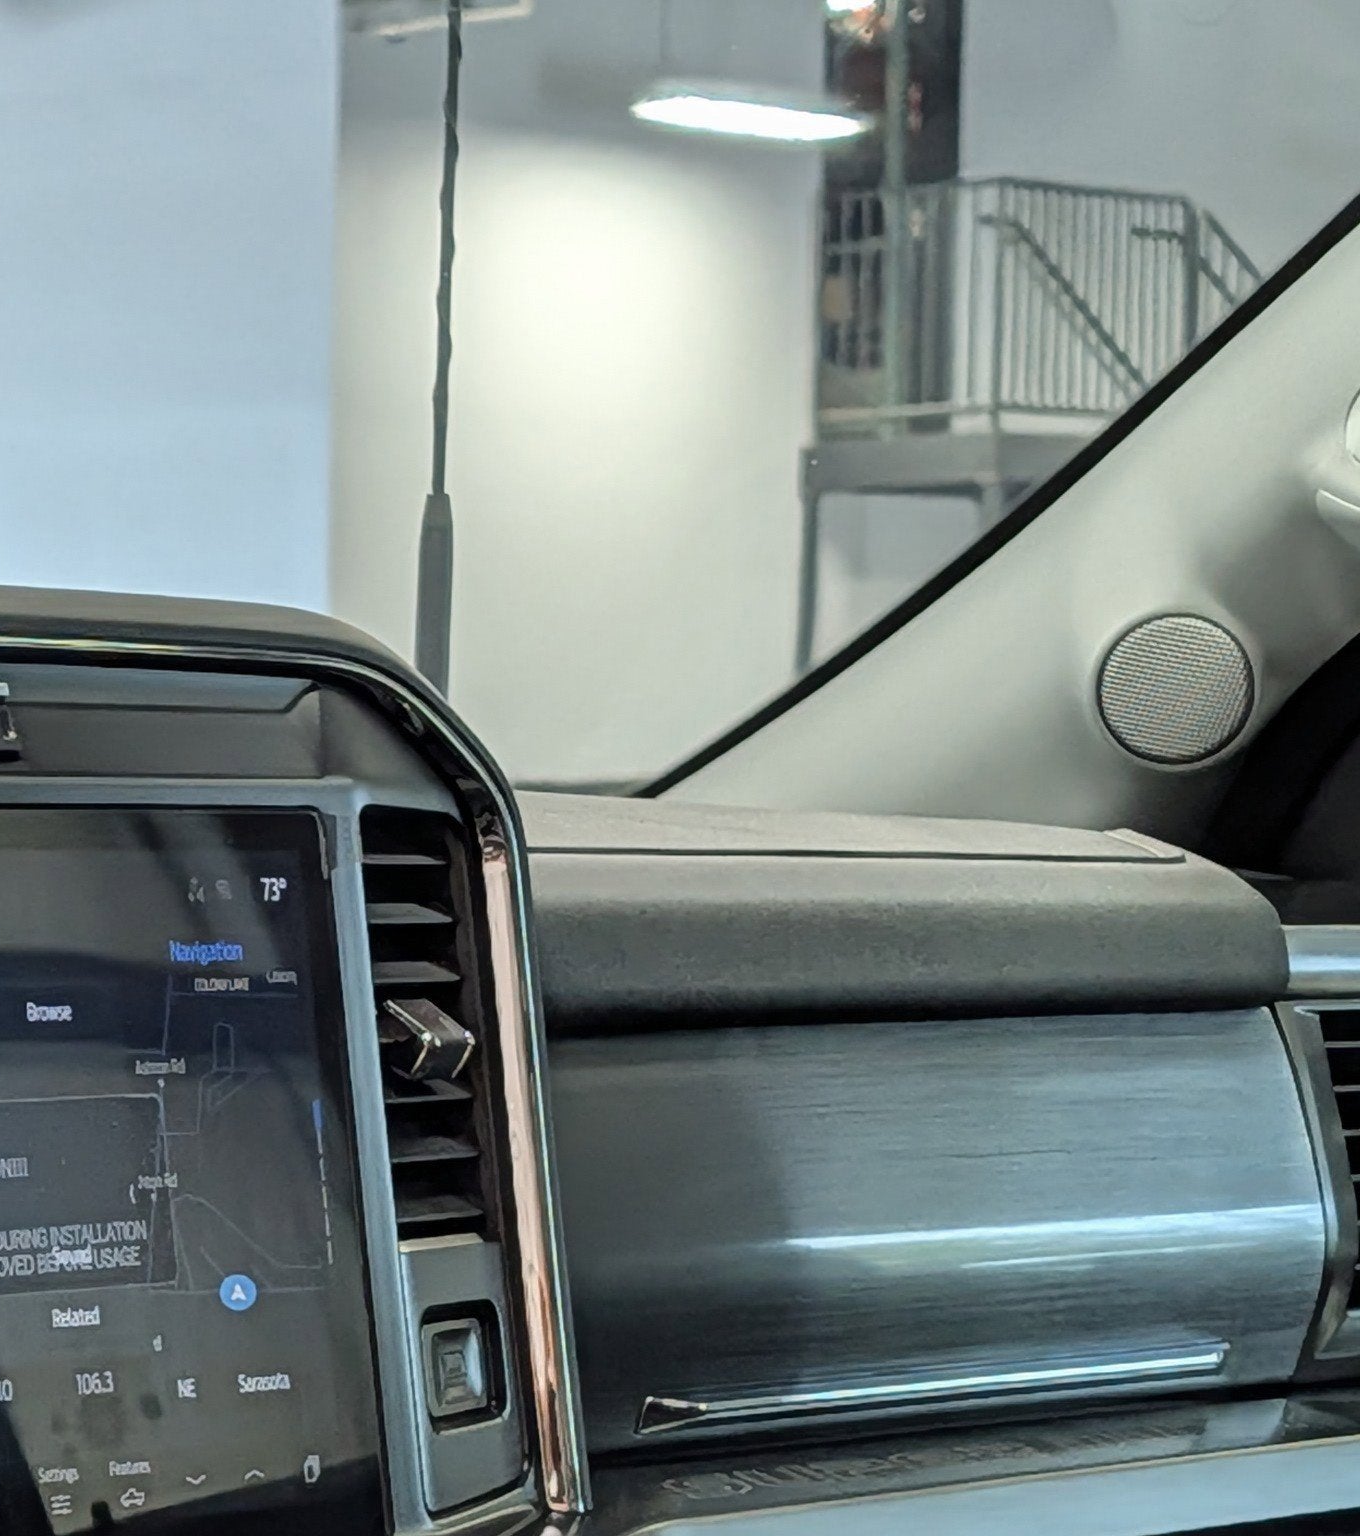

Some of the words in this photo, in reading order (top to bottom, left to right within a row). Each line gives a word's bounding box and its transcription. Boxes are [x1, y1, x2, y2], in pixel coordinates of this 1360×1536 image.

[169, 940, 244, 966] Navigation
[26, 1002, 73, 1022] Browse
[49, 1219, 148, 1247] INSTALLATION
[93, 1245, 142, 1269] USAGE
[51, 1306, 100, 1328] Related
[75, 1371, 114, 1396] 106.3
